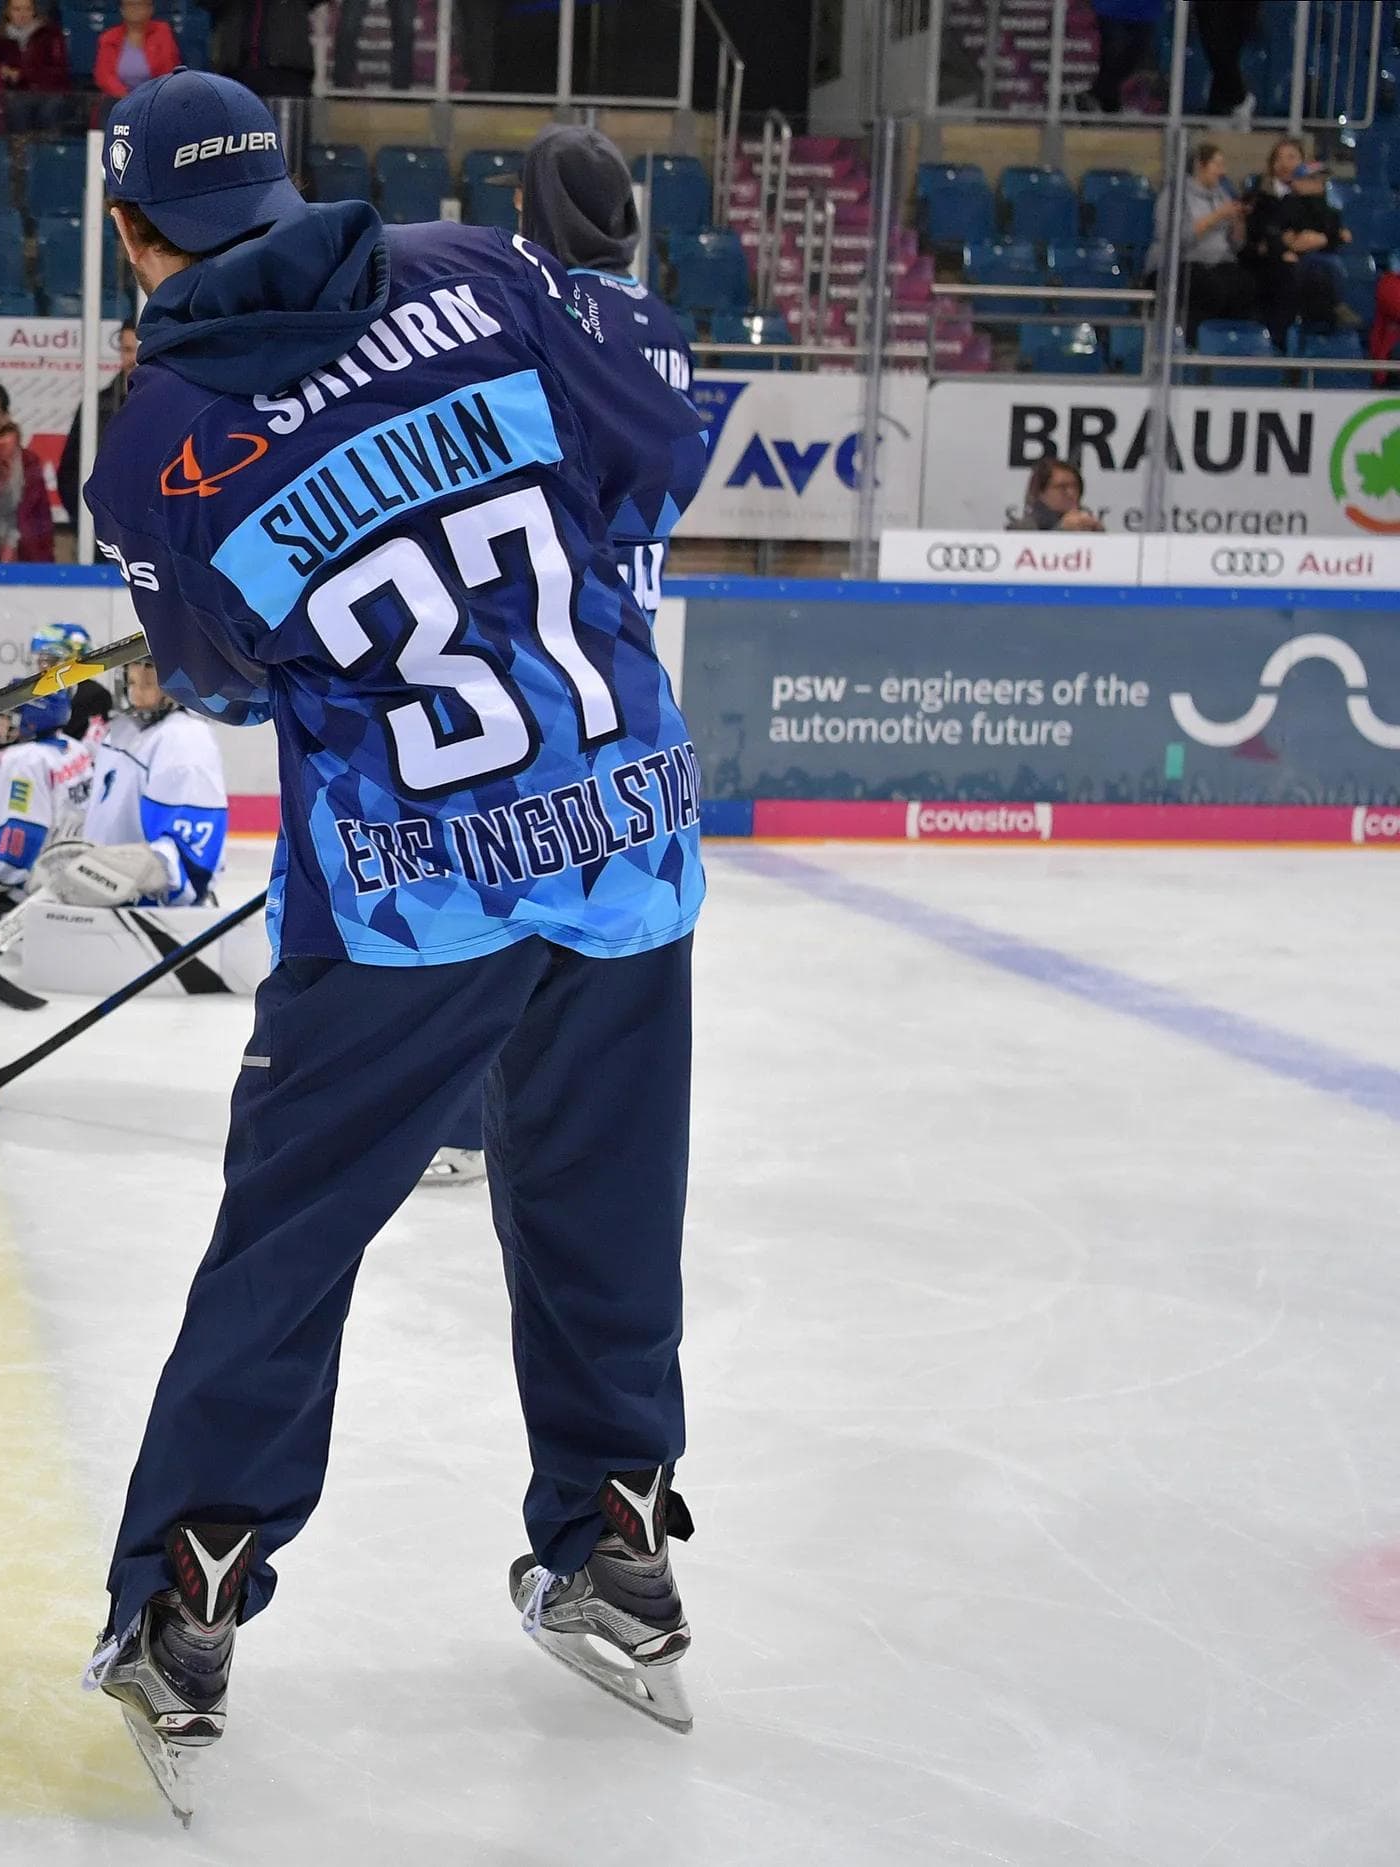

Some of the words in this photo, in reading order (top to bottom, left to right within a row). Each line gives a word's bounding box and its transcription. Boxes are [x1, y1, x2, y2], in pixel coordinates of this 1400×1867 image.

[113, 125, 130, 136] ERC
[173, 132, 278, 169] BAUER
[9, 327, 79, 349] Audi
[1008, 405, 1314, 476] BRAUN
[260, 392, 513, 577] SULLIVAN
[1014, 548, 1093, 572] Audi
[1298, 552, 1375, 576] Audi
[304, 484, 621, 793] 37
[771, 675, 848, 711] psw
[880, 671, 1045, 713] engineers
[1051, 672, 1090, 706] of
[1094, 673, 1150, 708] the
[768, 711, 963, 745] automotive
[970, 711, 1074, 747] future
[918, 806, 1035, 833] covestro
[334, 819, 449, 896] ERC
